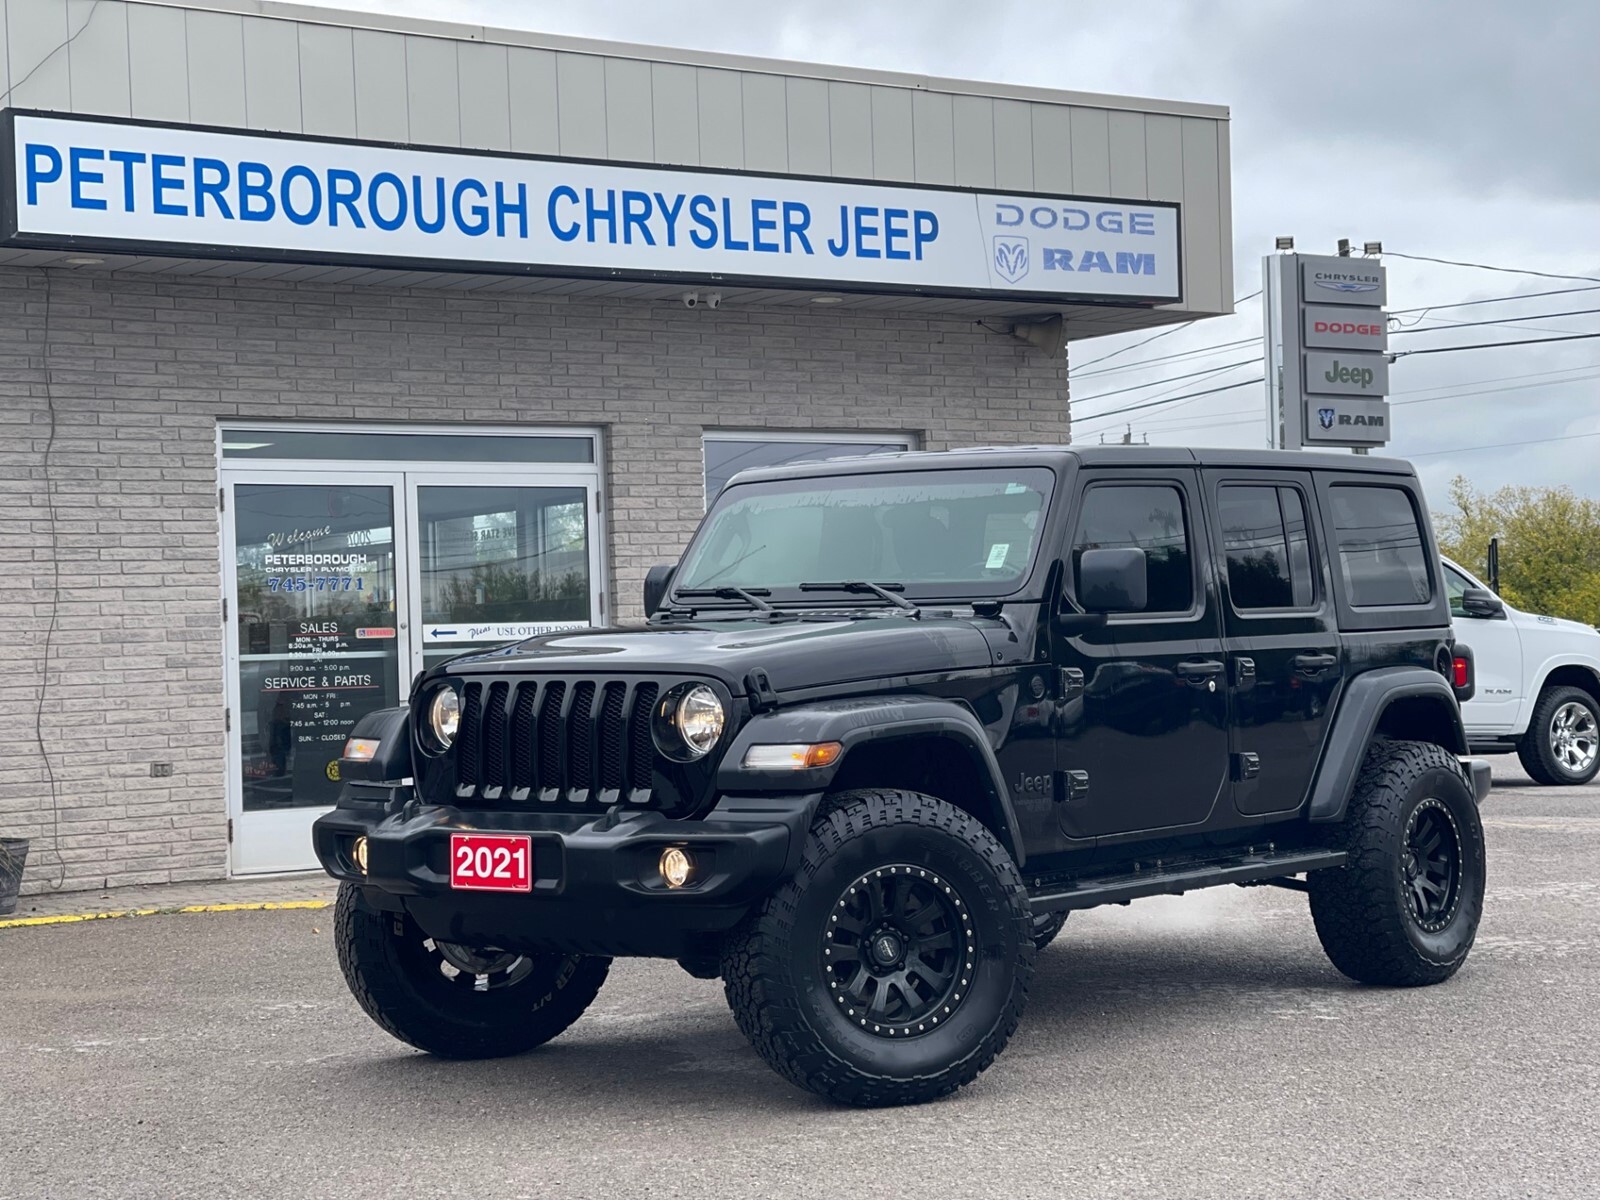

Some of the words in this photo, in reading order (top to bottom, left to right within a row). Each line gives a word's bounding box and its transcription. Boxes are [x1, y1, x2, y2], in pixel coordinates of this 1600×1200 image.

[25, 143, 528, 239] PETERBOROUGH
[547, 184, 814, 255] CHRYSLER
[827, 205, 940, 261] JEEP
[996, 203, 1155, 236] DODGE
[1043, 248, 1156, 276] RAM
[1315, 272, 1380, 283] CHRYSLER
[1314, 321, 1381, 336] DODGE
[1325, 360, 1374, 389] Jeep
[1338, 414, 1384, 427] RAM
[267, 525, 331, 547] Welcome
[265, 554, 367, 565] PETERBOROUGH
[267, 577, 365, 593] 745-7771
[300, 622, 338, 633] SALES
[497, 627, 515, 636] USE
[517, 626, 552, 636] OTHER
[264, 676, 316, 689] SERVICE
[321, 676, 329, 687] &
[334, 674, 371, 686] PARTS
[1014, 772, 1052, 794] Jeep
[456, 846, 525, 879] 2021
